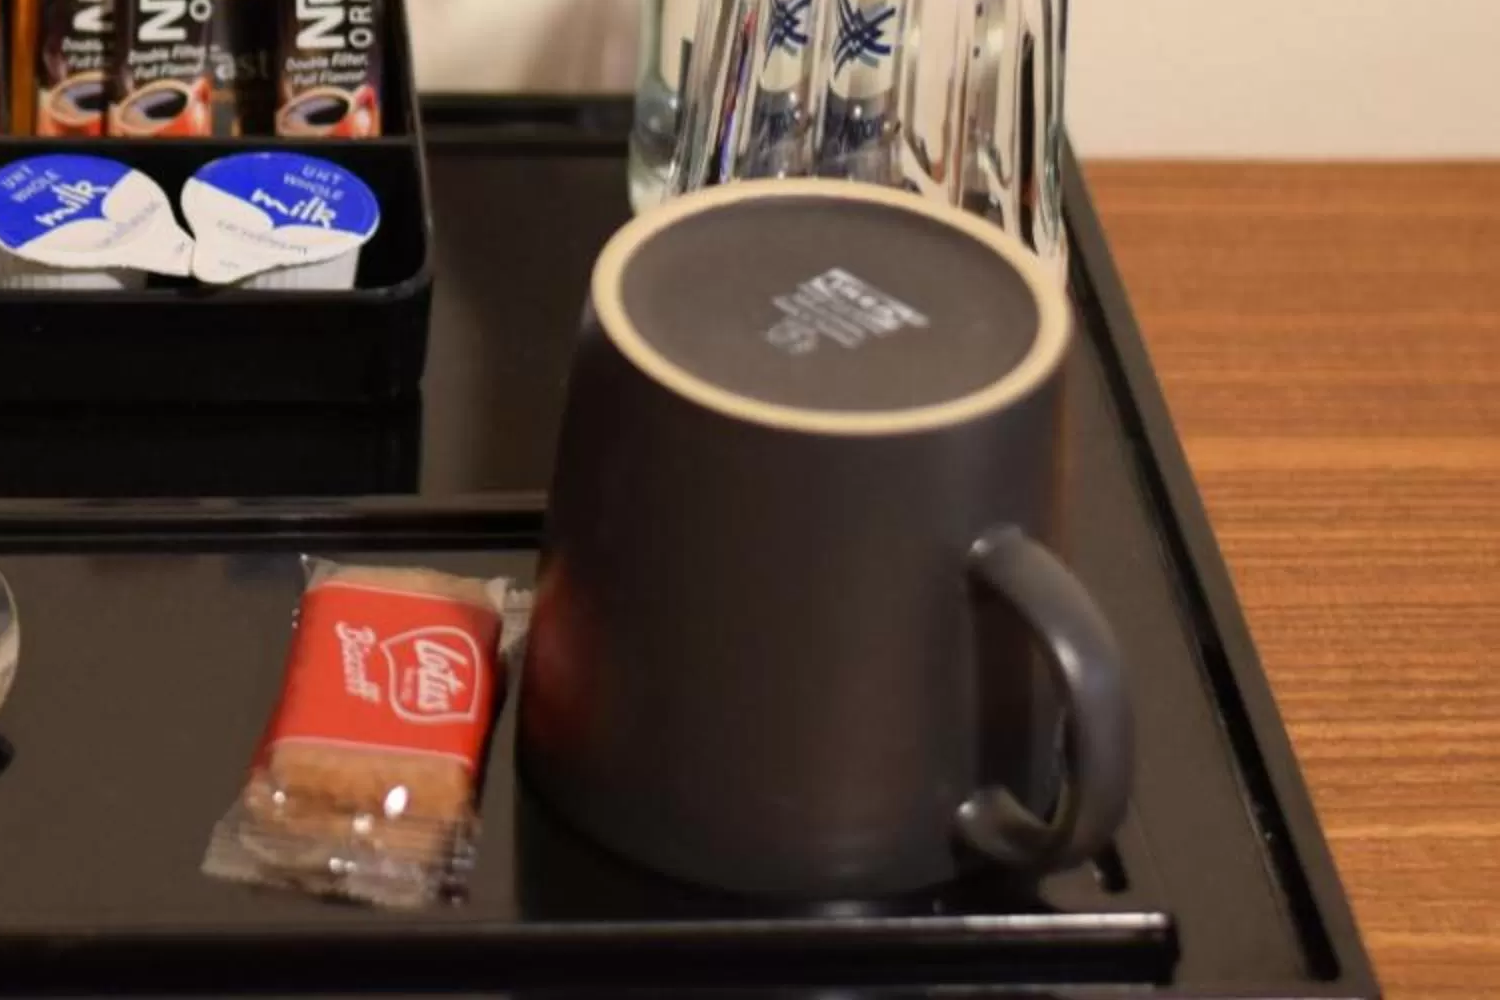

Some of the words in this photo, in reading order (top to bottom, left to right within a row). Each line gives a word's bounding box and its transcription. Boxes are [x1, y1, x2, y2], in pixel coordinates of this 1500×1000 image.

[302, 164, 343, 185] UHT
[34, 180, 110, 227] milk
[251, 188, 337, 230] milk
